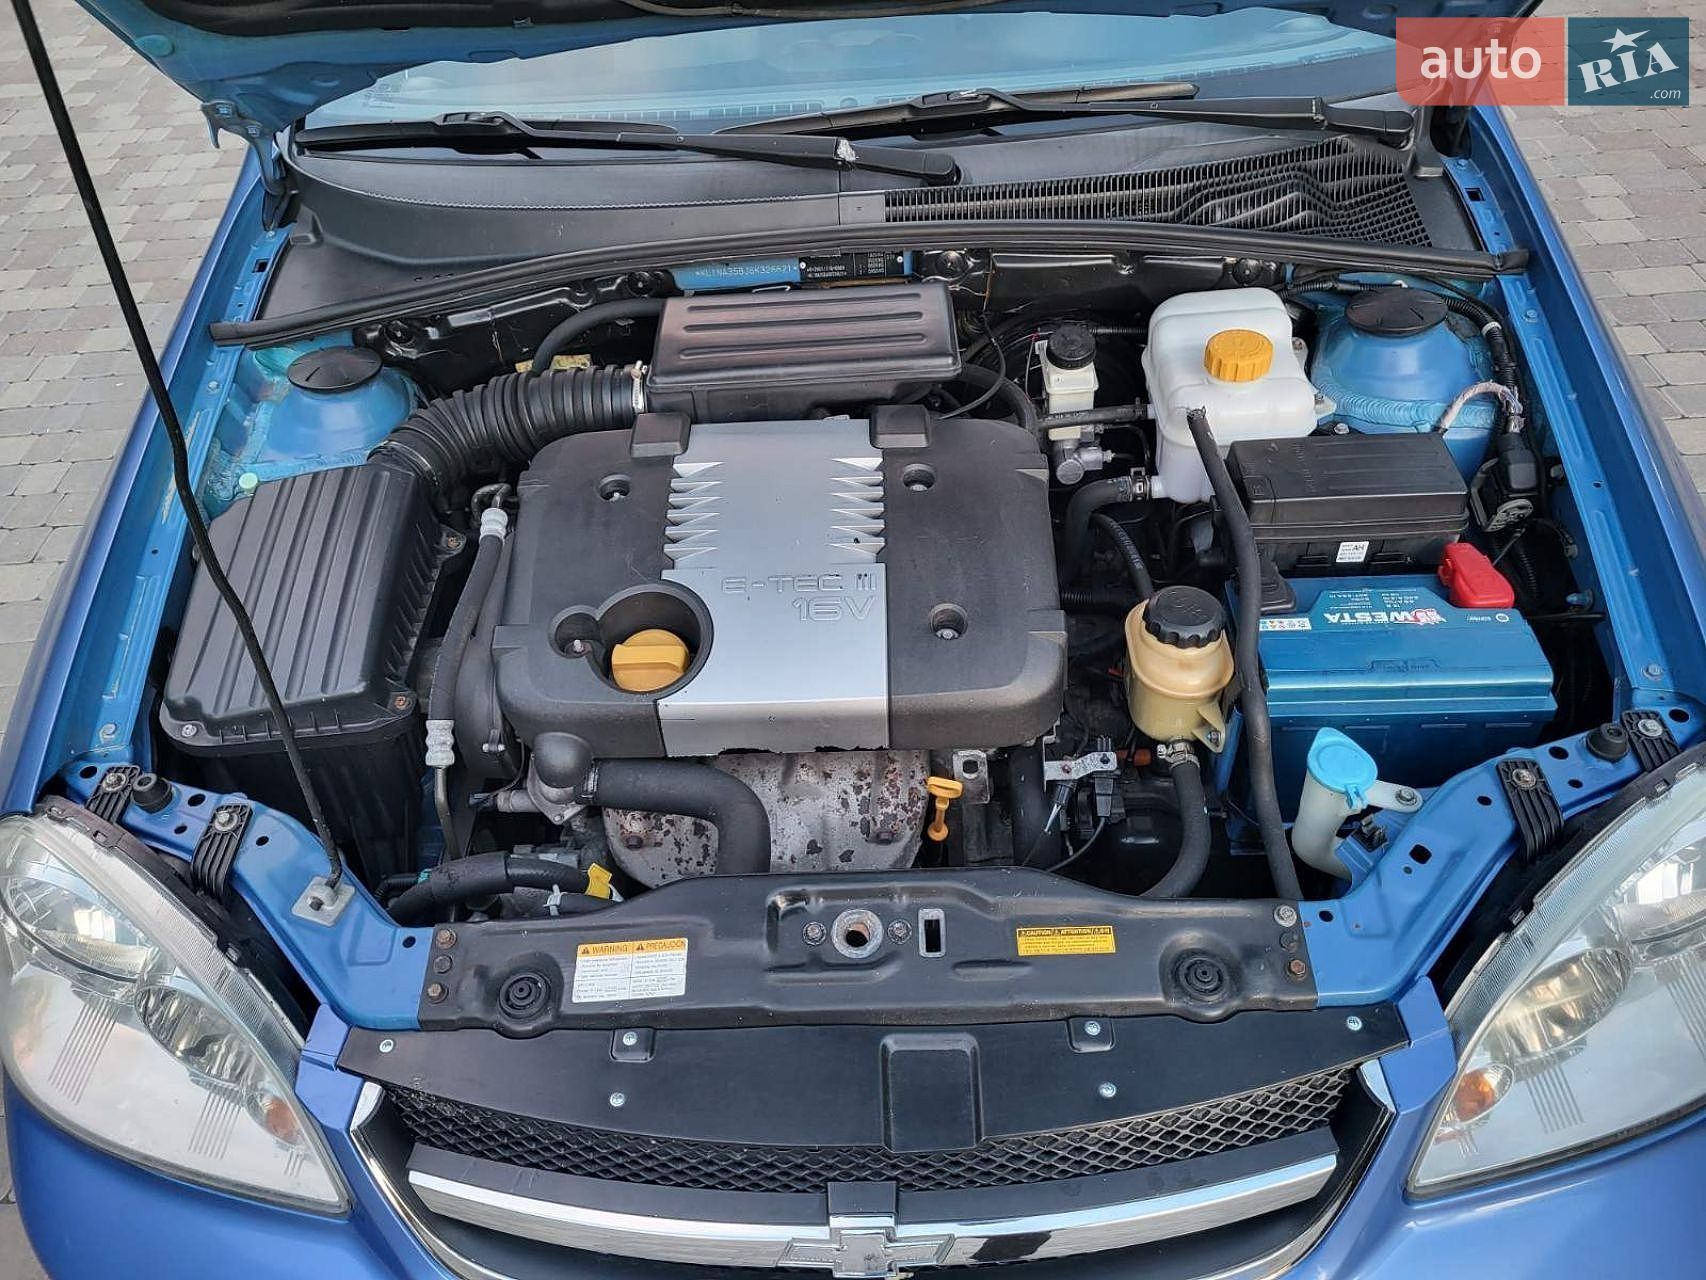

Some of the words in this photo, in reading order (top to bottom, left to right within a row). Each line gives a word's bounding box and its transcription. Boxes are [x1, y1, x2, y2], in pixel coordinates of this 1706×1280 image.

[721, 574, 844, 594] E-TEC
[792, 595, 876, 621] 16V
[1323, 610, 1417, 624] WESTA
[592, 943, 628, 954] WARNING
